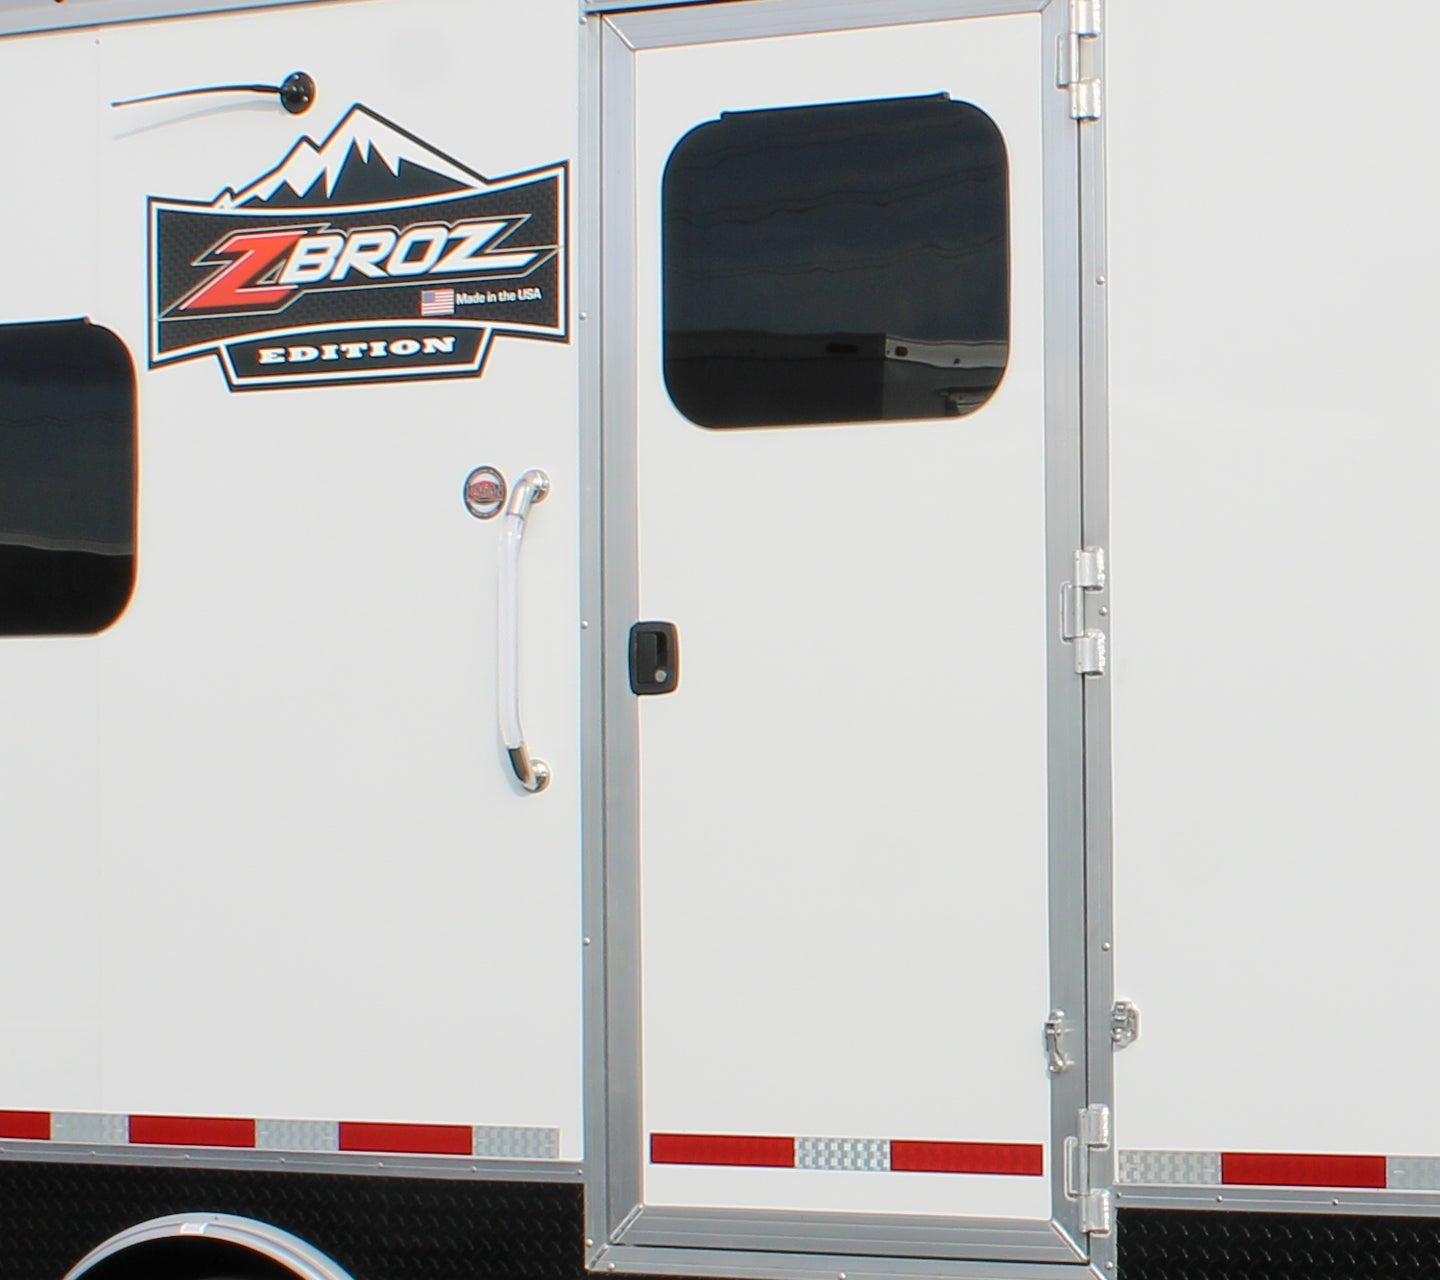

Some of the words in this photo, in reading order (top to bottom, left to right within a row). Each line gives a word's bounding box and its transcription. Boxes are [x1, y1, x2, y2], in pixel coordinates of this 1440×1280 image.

[178, 221, 541, 310] ZBROZ
[456, 292, 486, 305] Made
[487, 291, 497, 303] in
[498, 290, 516, 302] the
[517, 287, 542, 300] USA
[258, 336, 456, 365] EDITION
